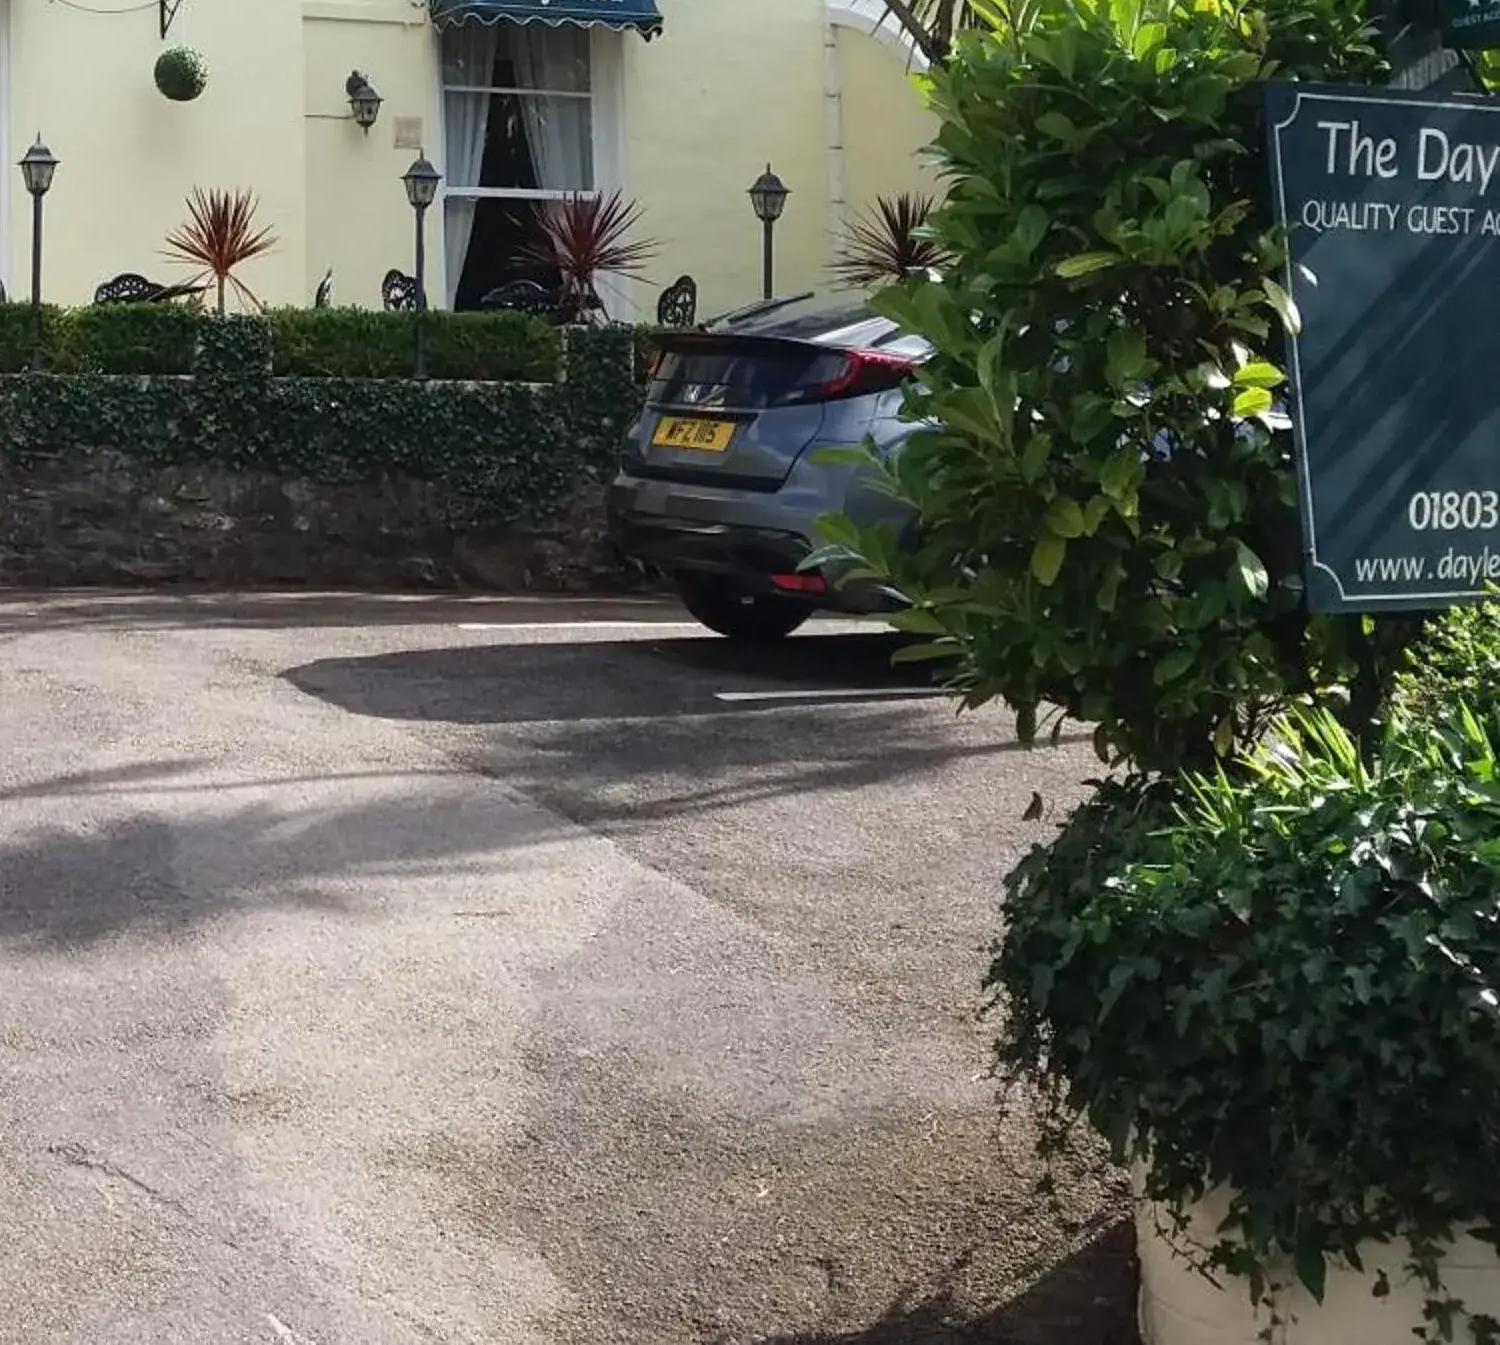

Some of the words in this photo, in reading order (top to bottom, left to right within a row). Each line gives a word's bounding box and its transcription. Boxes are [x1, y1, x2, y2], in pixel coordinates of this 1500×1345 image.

[1317, 120, 1398, 178] The
[1417, 127, 1500, 196] Day
[1303, 199, 1400, 232] QUALITY
[1407, 206, 1475, 234] GUEST
[1409, 491, 1499, 530] 01803
